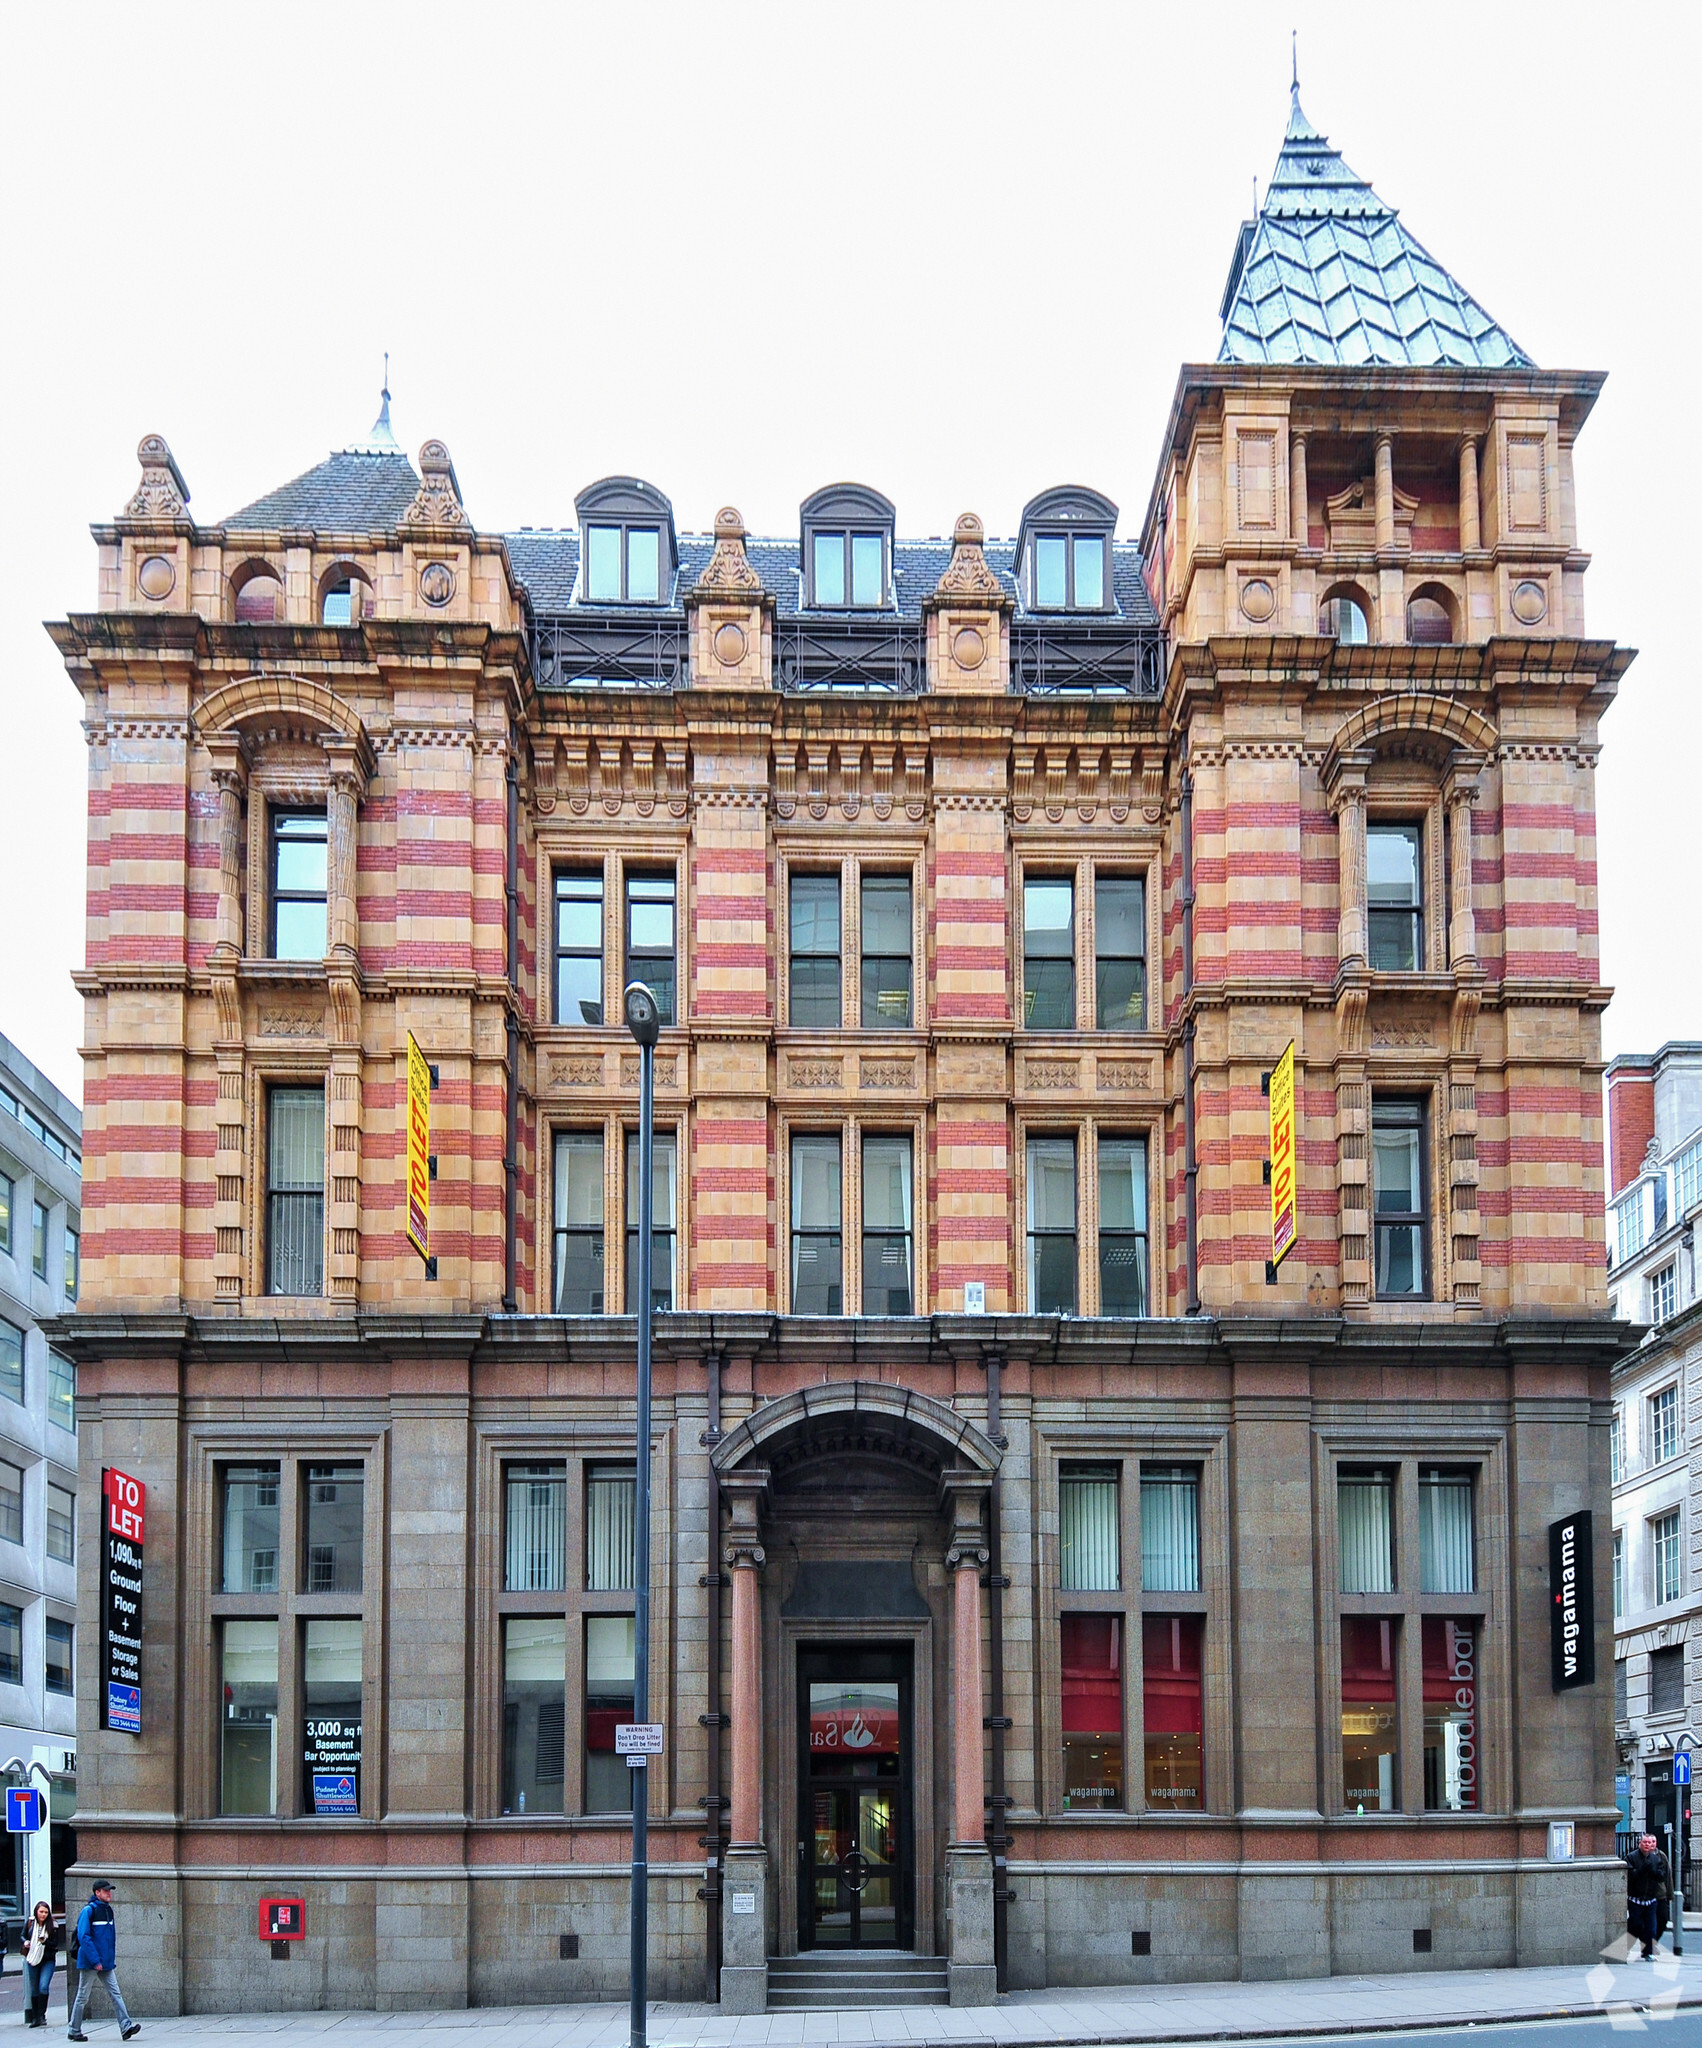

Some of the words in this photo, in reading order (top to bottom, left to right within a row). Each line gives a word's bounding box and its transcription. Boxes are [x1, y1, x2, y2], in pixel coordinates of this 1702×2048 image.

[1272, 1086, 1291, 1121] Suites
[412, 1096, 426, 1165] LET
[1274, 1108, 1290, 1171] LET
[411, 1160, 426, 1207] TO
[1275, 1167, 1290, 1217] TO
[115, 1474, 139, 1507] TO
[111, 1503, 142, 1539] LET
[110, 1569, 142, 1593] Ground
[114, 1594, 137, 1614] Floor
[1561, 1525, 1580, 1678] wagamama
[108, 1630, 142, 1650] Basement
[112, 1647, 138, 1666] Storage
[1449, 1624, 1474, 1682] bar
[111, 1666, 119, 1676] or
[120, 1665, 139, 1681] Sales
[307, 1721, 341, 1738] 3,000
[343, 1727, 355, 1739] sq
[304, 1750, 318, 1761] Bar
[315, 1739, 354, 1750] Basement
[1449, 1687, 1476, 1806] noodle
[315, 1786, 338, 1794] Pudney
[1069, 1786, 1115, 1799] wagamama
[1151, 1787, 1196, 1799] wagamama
